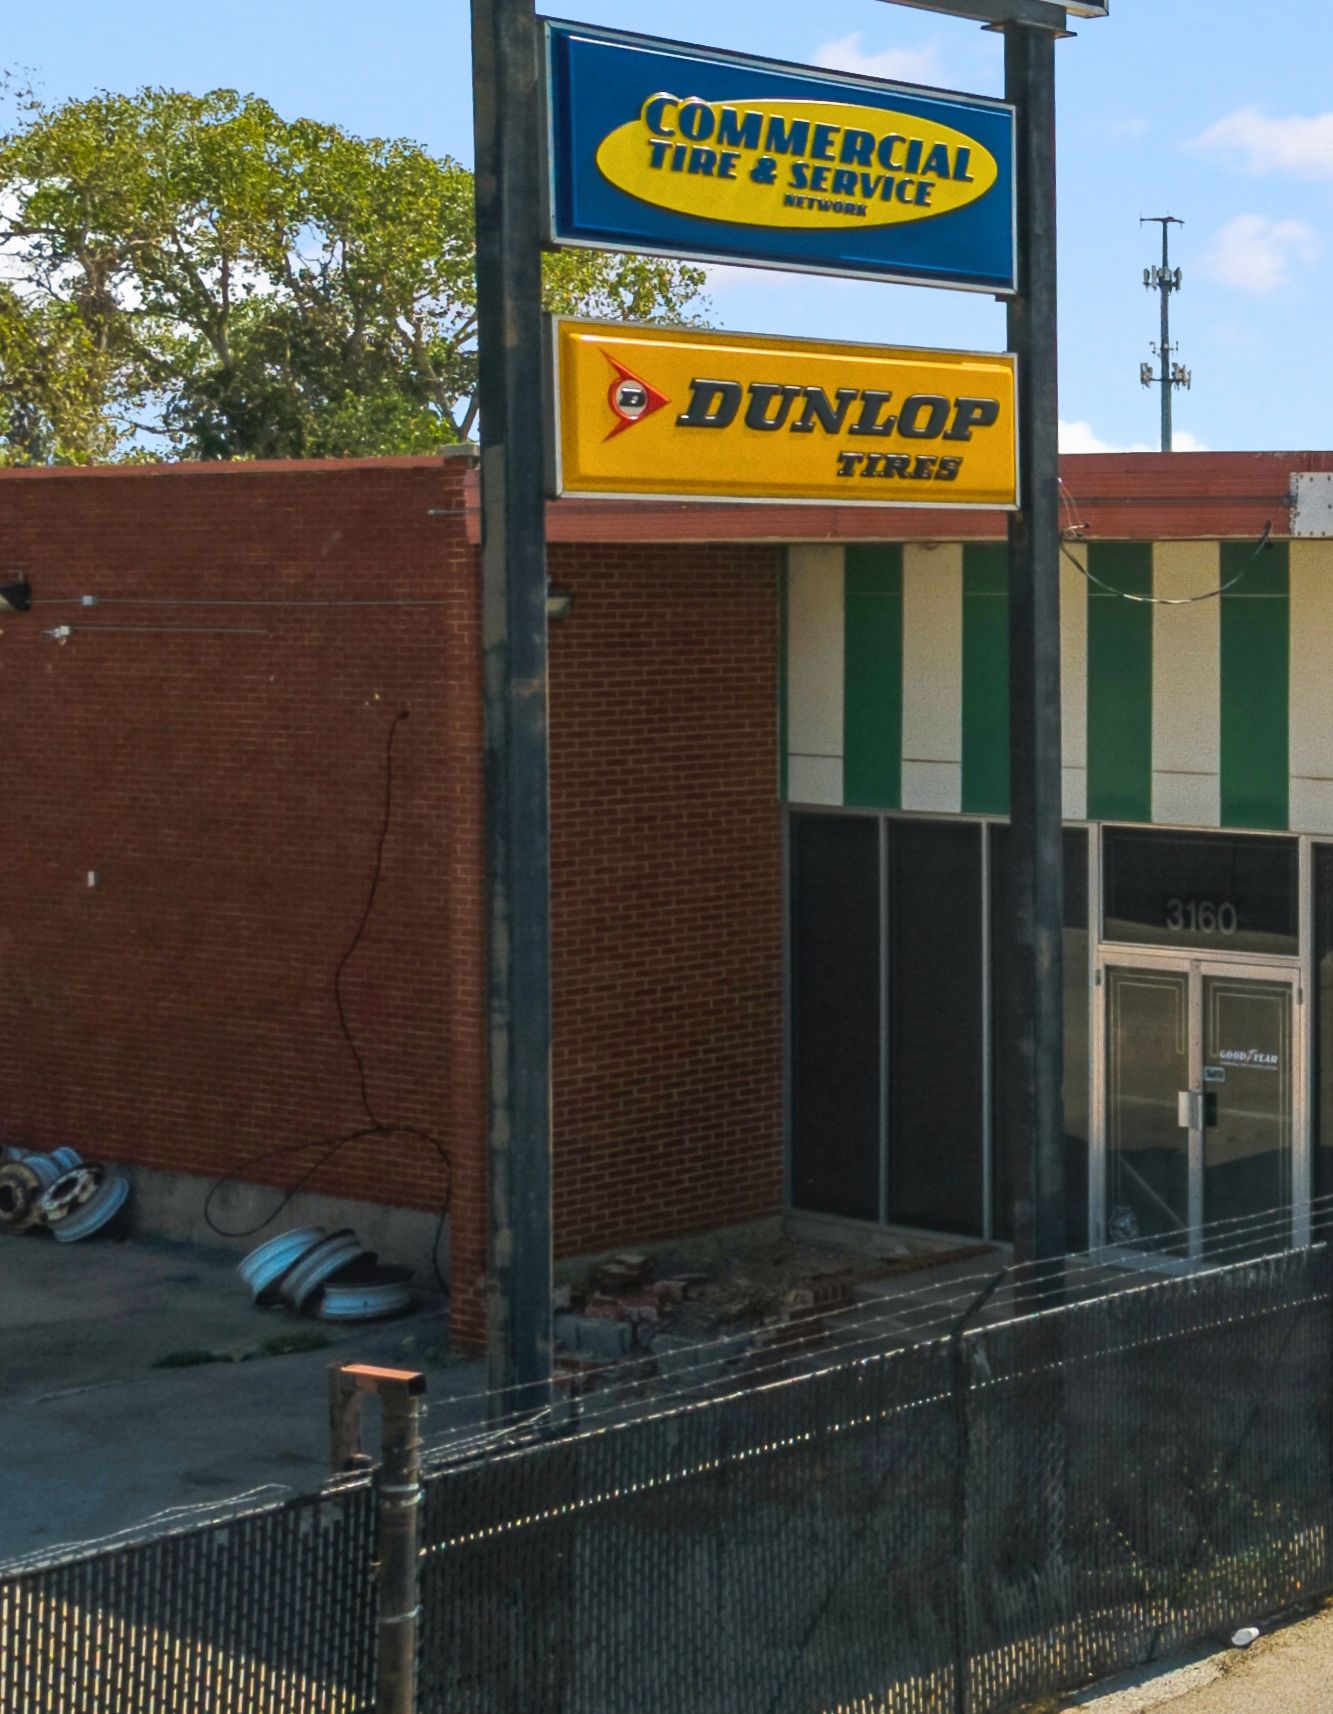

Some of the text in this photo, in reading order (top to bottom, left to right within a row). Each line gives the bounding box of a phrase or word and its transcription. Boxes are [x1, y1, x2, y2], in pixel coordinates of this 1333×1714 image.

[645, 95, 975, 182] COMMERCIAL
[648, 139, 935, 207] TIRE & SERVICE
[783, 193, 867, 217] NETWORK
[675, 378, 999, 442] DUNLOP
[836, 451, 963, 481] TIRES
[1166, 898, 1237, 935] 3160
